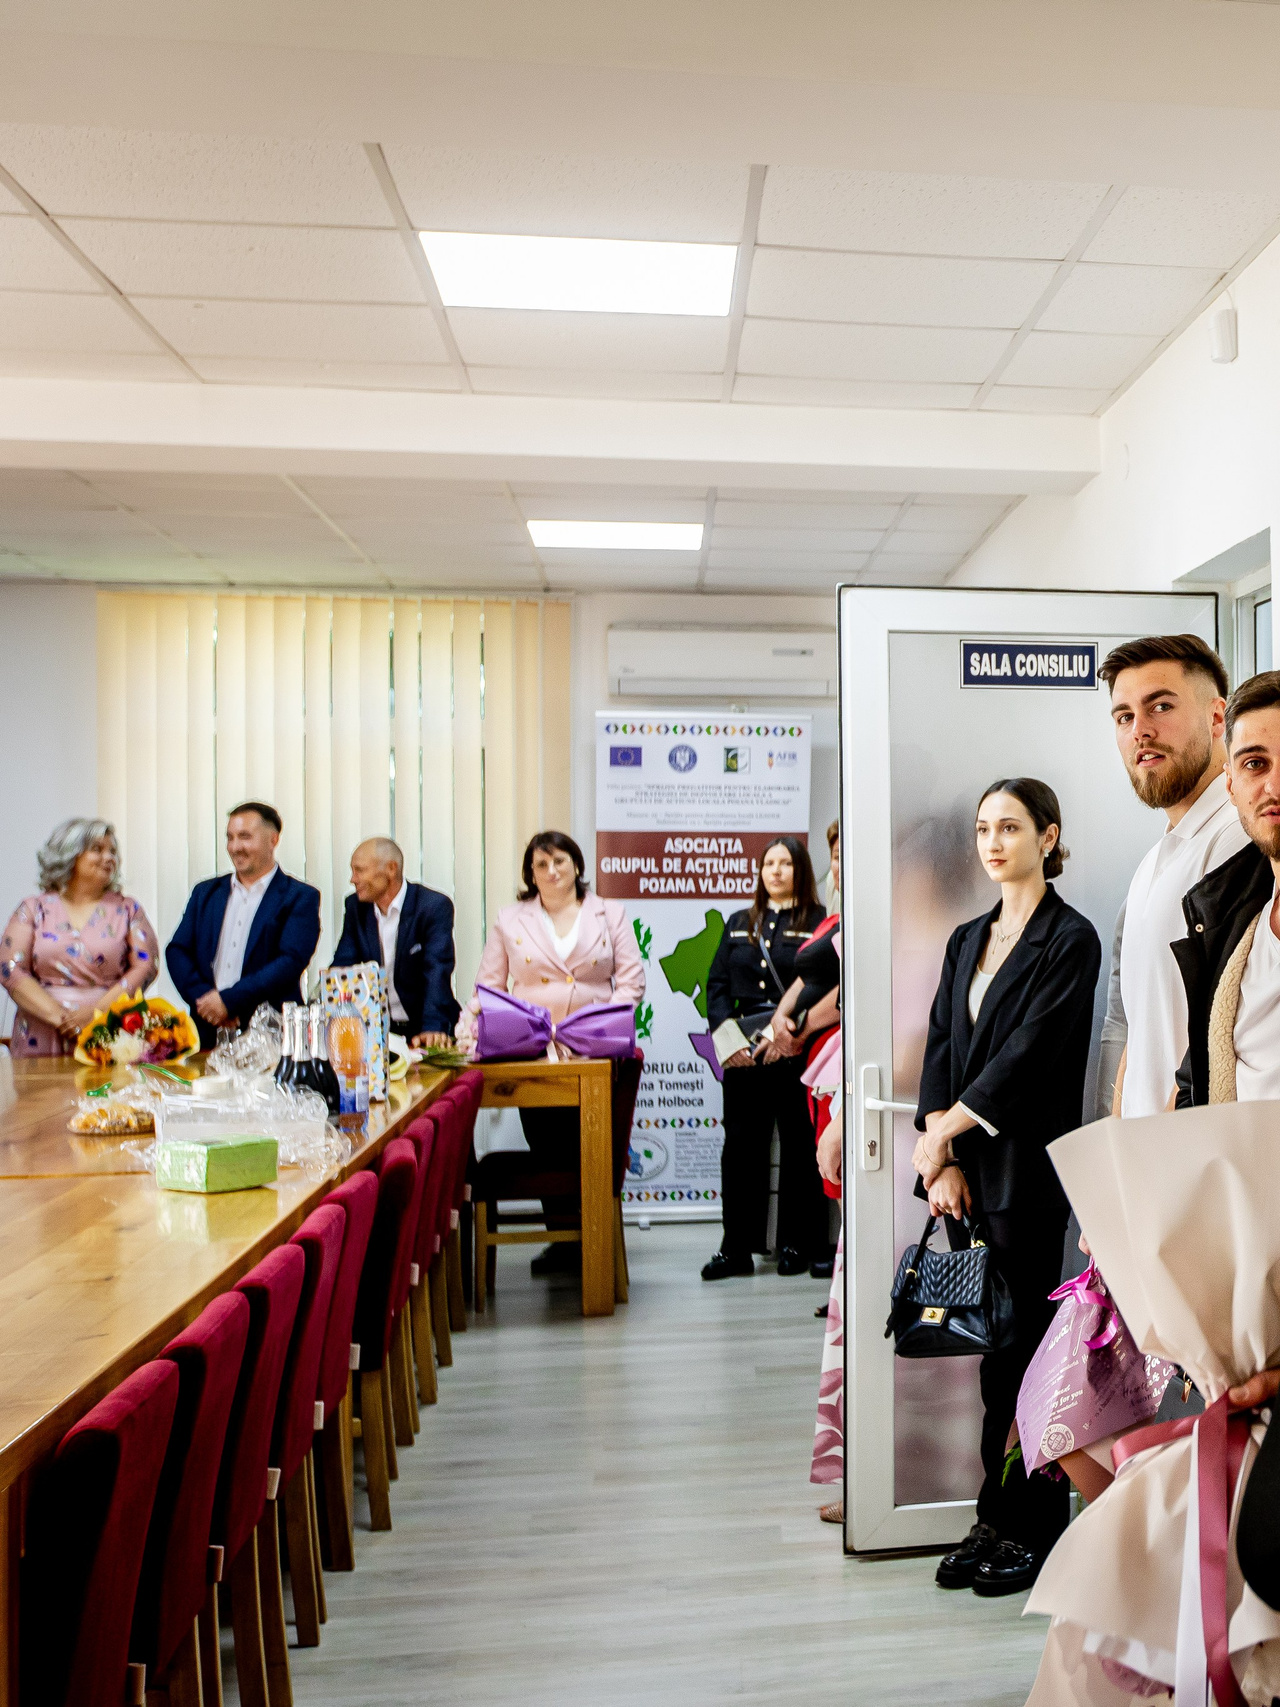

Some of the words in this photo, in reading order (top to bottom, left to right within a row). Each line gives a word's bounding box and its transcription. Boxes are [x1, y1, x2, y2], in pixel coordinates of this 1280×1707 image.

[970, 652, 1012, 676] SALA
[1015, 653, 1090, 678] CONSILIU
[600, 856, 660, 874] GRUPUL
[662, 857, 682, 874] DE
[639, 877, 696, 893] POIANA
[658, 1096, 704, 1108] Holboca
